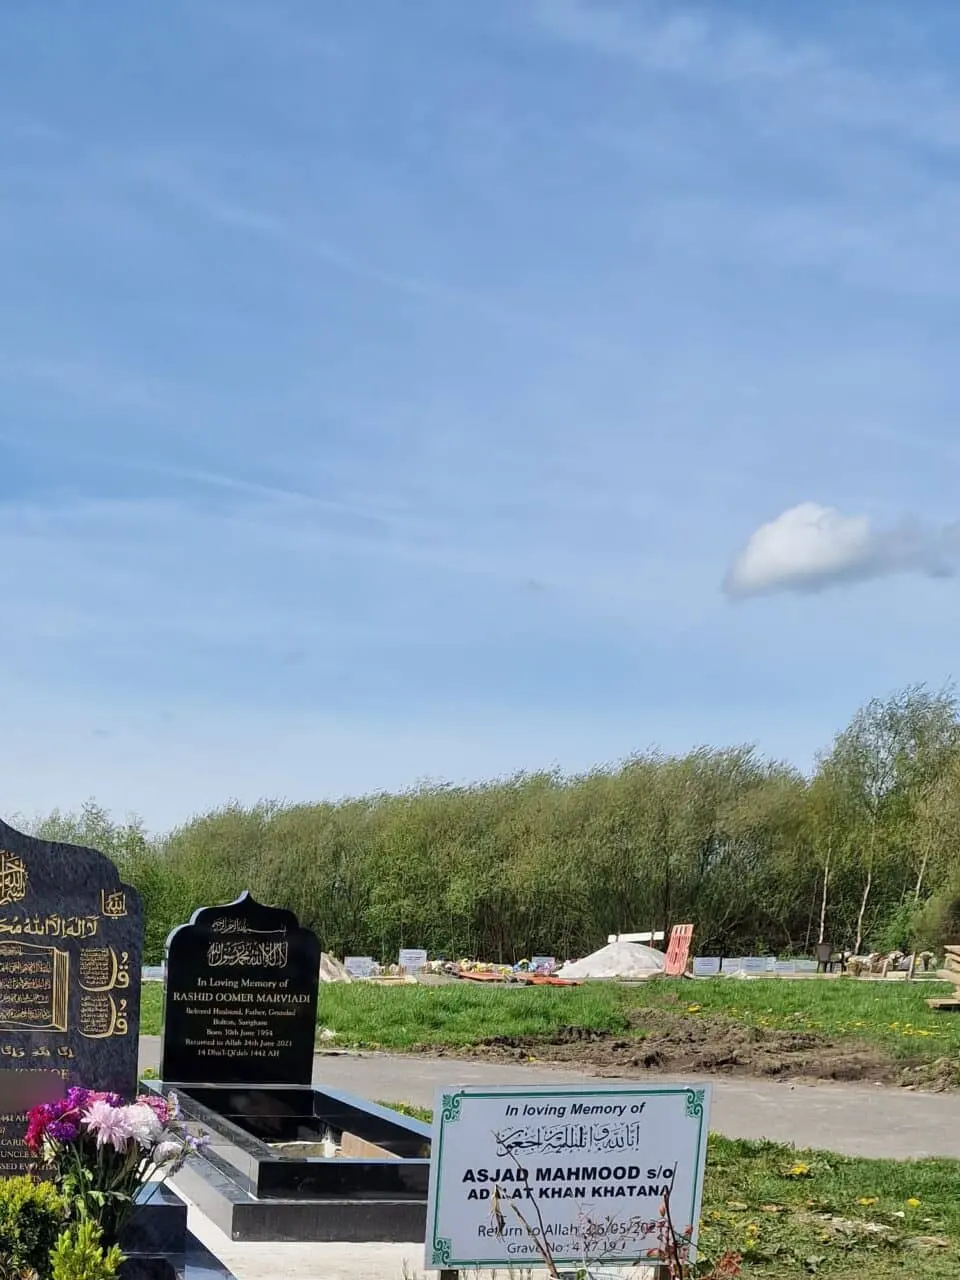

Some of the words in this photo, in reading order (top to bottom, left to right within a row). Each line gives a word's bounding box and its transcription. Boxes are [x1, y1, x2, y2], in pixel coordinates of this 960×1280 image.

[197, 977, 207, 987] In
[209, 977, 239, 988] Loving
[241, 978, 276, 989] Memory
[173, 992, 213, 1001] RASHID
[506, 1104, 518, 1116] In
[523, 1104, 566, 1118] loving
[570, 1102, 627, 1117] Memory
[630, 1102, 646, 1114] of
[462, 1168, 529, 1182] ASJAD
[535, 1166, 640, 1182] MAHMOOD
[647, 1165, 673, 1179] s/o
[538, 1187, 585, 1199] KHAN
[591, 1185, 668, 1198] KHATANA
[478, 1224, 523, 1237] Return
[544, 1223, 578, 1236] Allah
